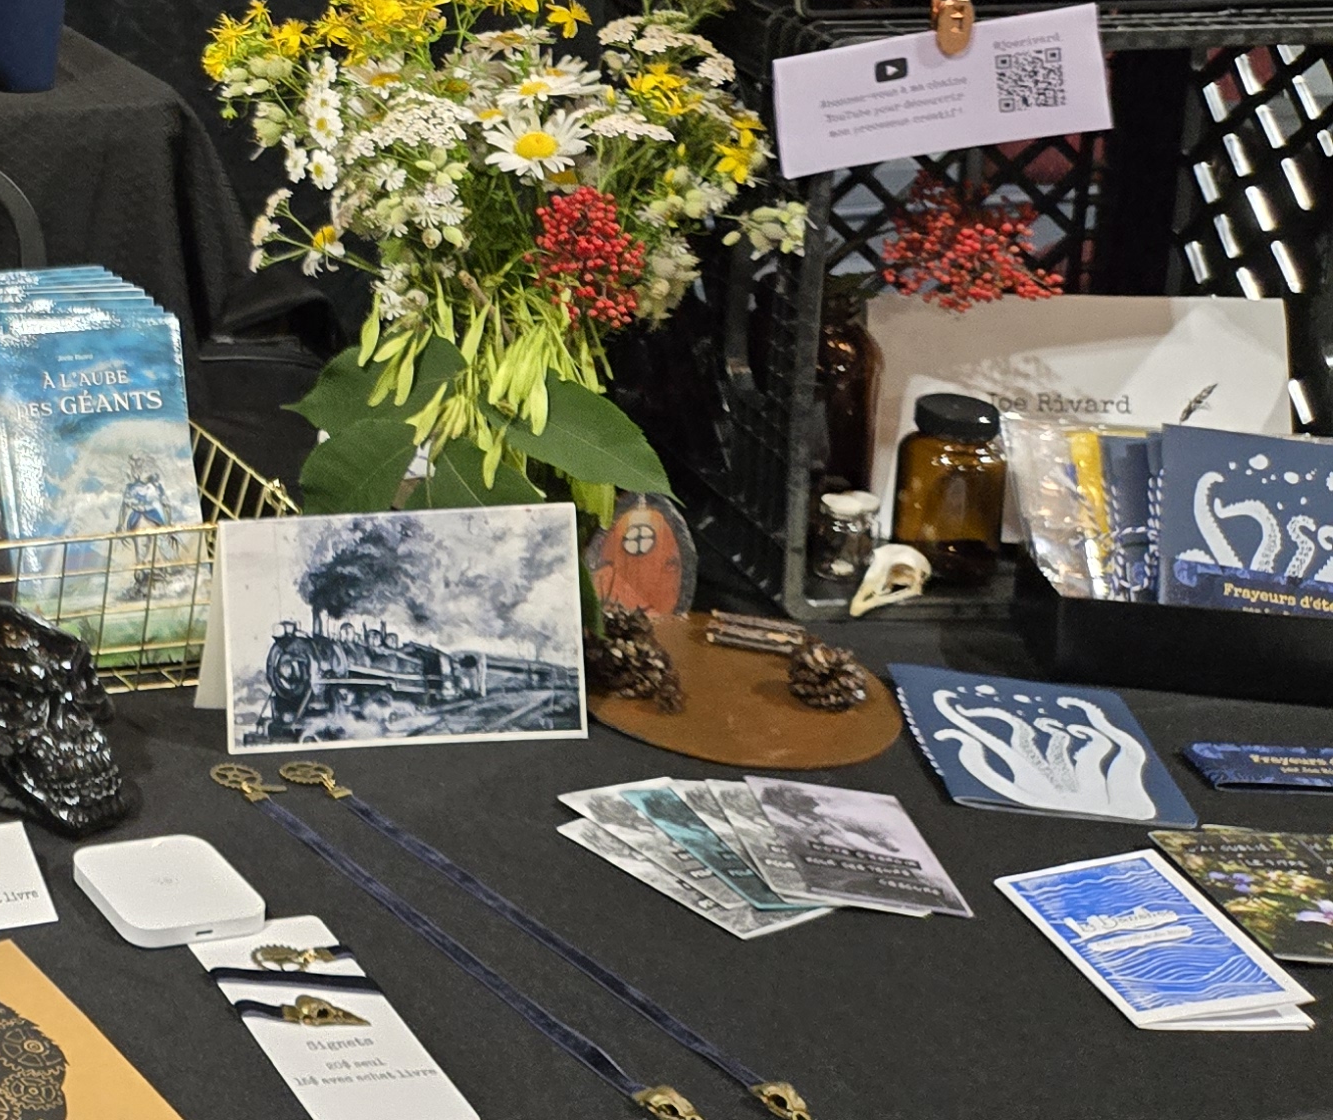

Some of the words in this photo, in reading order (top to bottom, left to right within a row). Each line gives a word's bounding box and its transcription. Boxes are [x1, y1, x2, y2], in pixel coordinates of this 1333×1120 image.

[43, 371, 55, 390] À
[61, 370, 131, 390] L'AUBE
[17, 402, 53, 418] DES
[60, 389, 163, 414] GÉANTS
[987, 392, 1028, 412] Joe
[1037, 392, 1131, 414] Rivard
[1223, 582, 1296, 606] Frayeurs
[4, 890, 39, 903] livre
[306, 1037, 374, 1051] Signets
[353, 1057, 388, 1068] seul
[322, 1076, 354, 1085] avec
[356, 1071, 396, 1082] achat
[397, 1069, 438, 1079] livre
